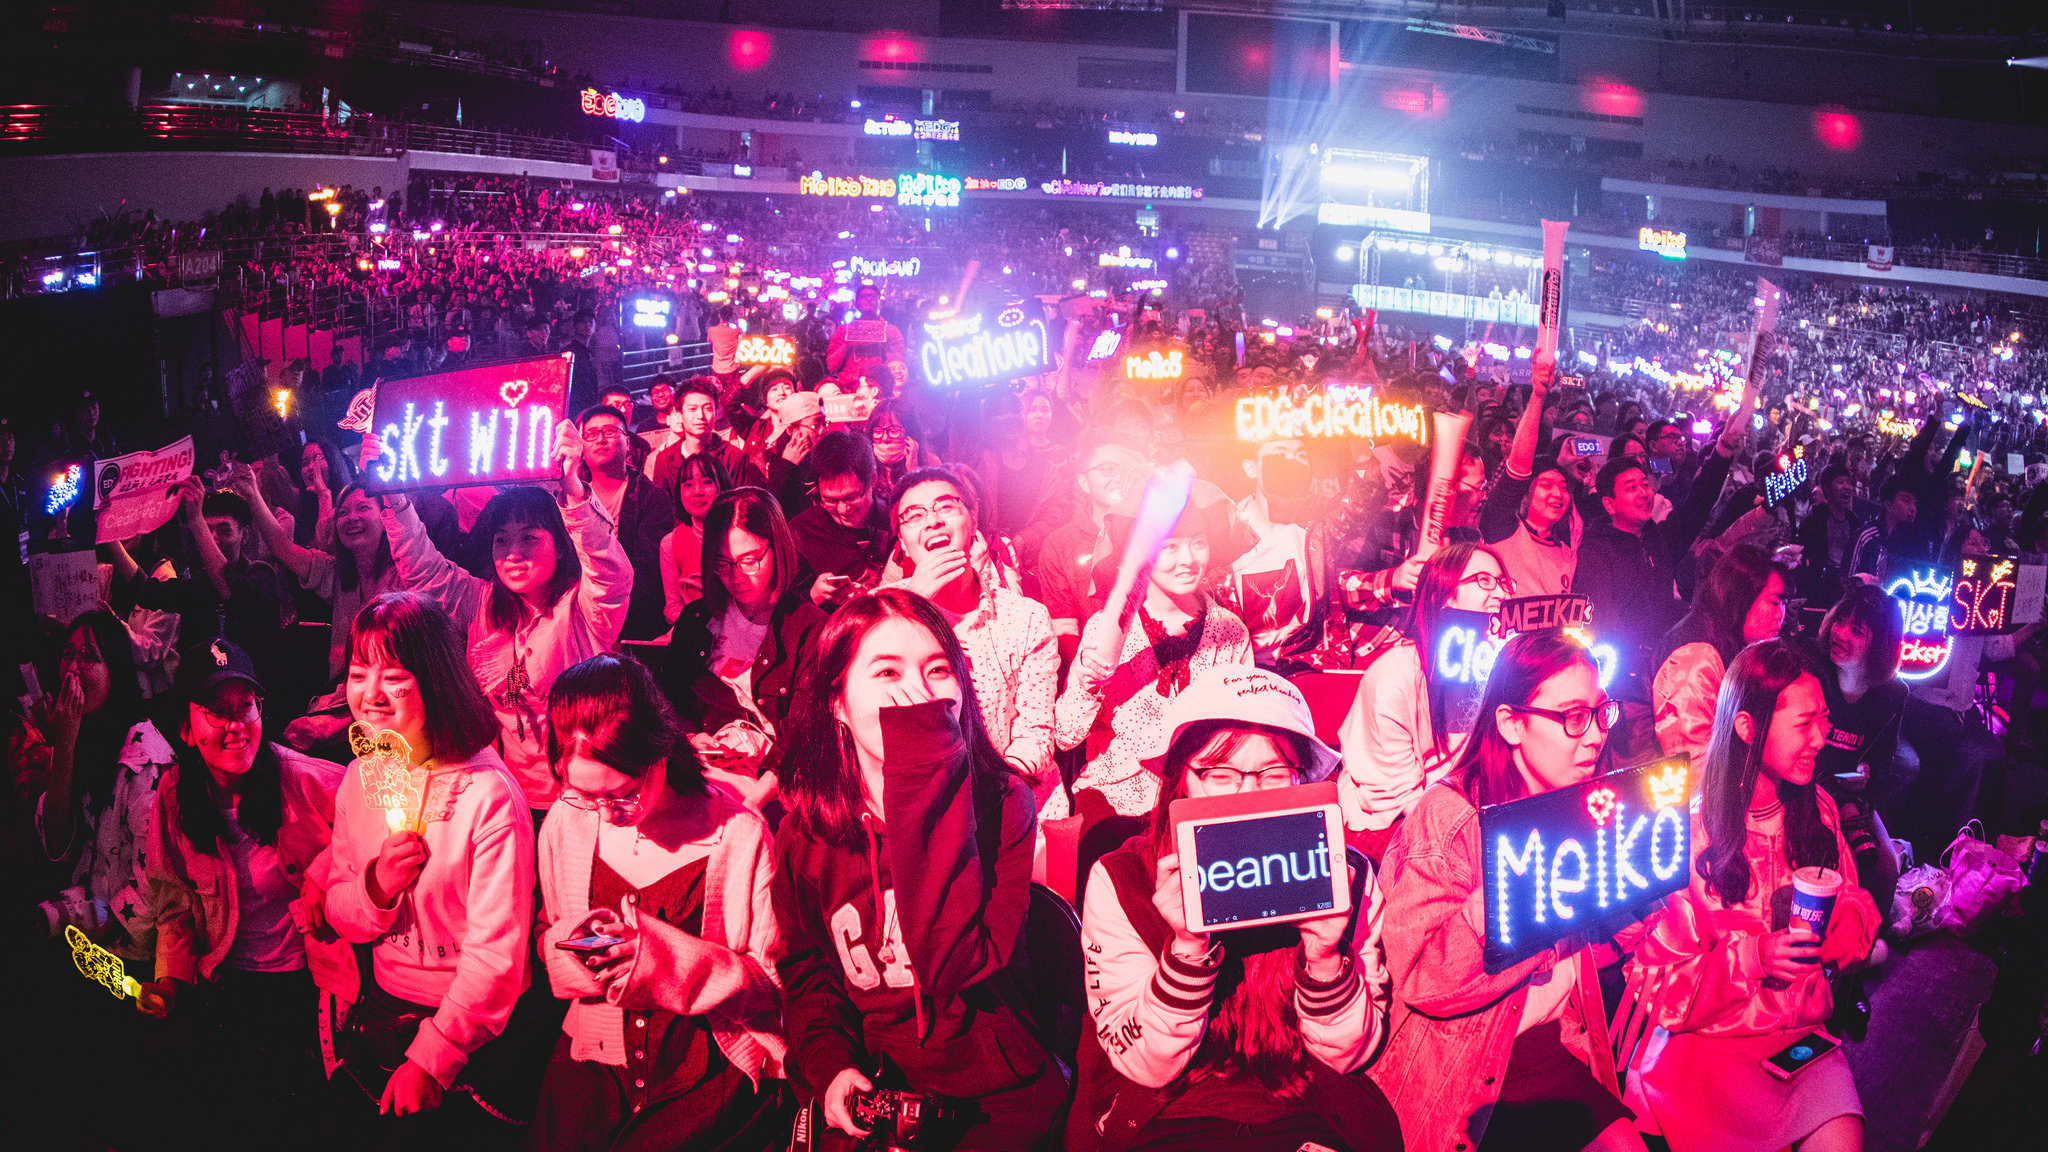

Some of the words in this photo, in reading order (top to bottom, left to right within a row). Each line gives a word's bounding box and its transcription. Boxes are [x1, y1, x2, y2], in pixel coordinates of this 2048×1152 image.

[996, 177, 1028, 190] EDG
[184, 256, 218, 275] A204
[738, 339, 794, 364] Scout
[1561, 376, 1583, 387] SKT
[1236, 396, 1292, 441] EDG
[1577, 442, 1595, 452] EDG
[1500, 597, 1587, 636] MEIKO
[1951, 579, 2016, 630] SKT
[1832, 728, 1859, 746] TEAM
[390, 931, 461, 958] OSSIBL
[1087, 942, 1102, 989] LIFE
[796, 1107, 809, 1144] Nikon
